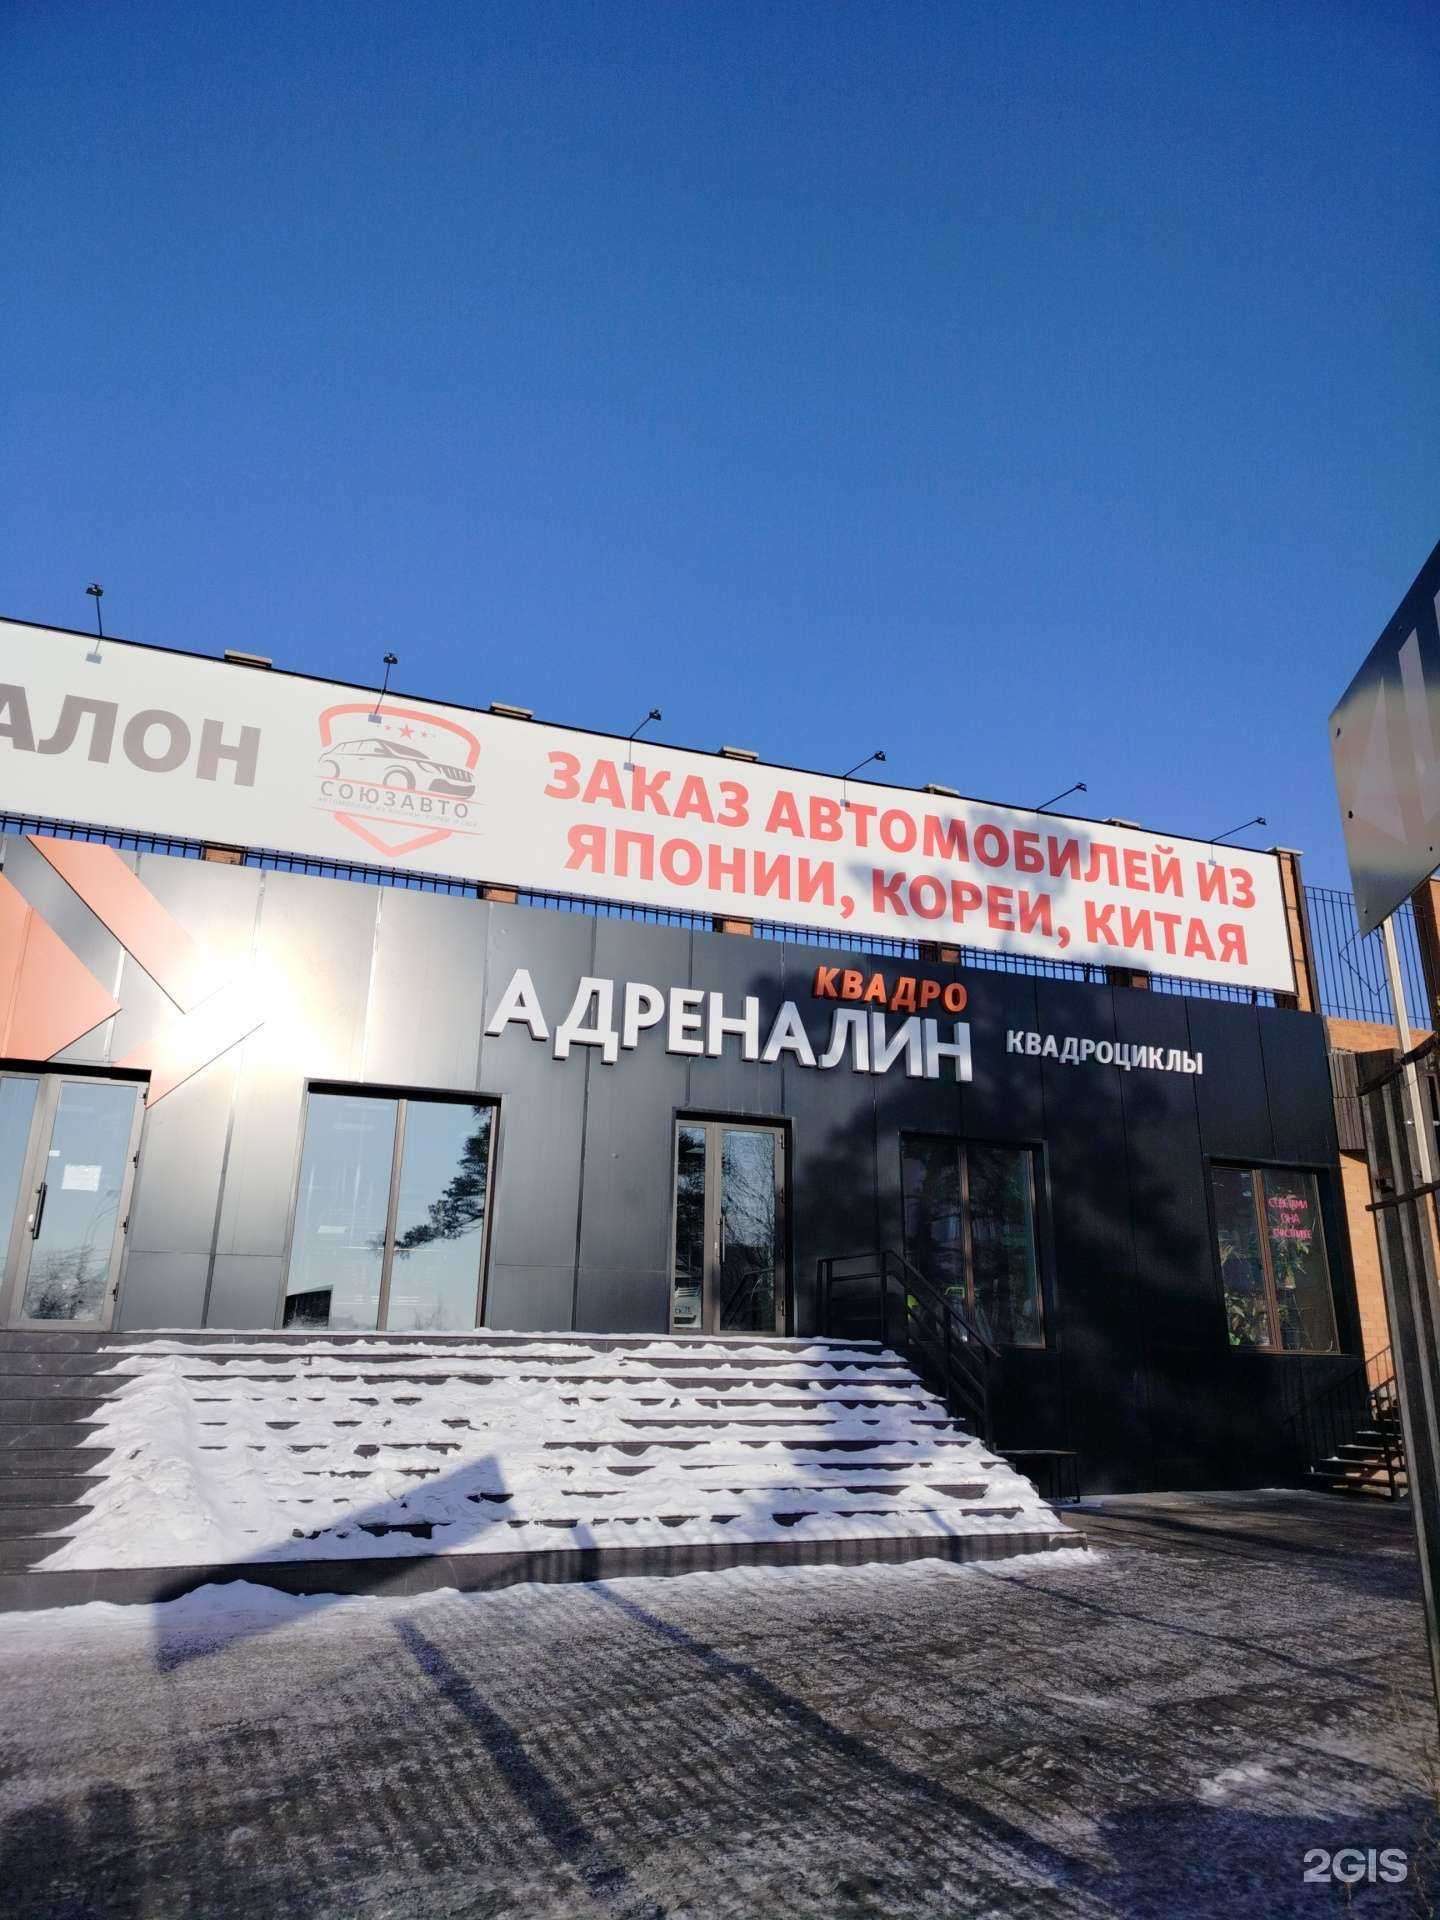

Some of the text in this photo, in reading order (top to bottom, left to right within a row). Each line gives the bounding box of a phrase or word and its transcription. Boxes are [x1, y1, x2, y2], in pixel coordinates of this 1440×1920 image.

[320, 780, 469, 819] СОЮЗАВТО
[545, 751, 750, 827] ЗАКАЗ
[766, 791, 1184, 897] АВТОМОБИЛЕЙ
[1196, 862, 1256, 909] ИЗ
[565, 824, 1249, 966] ЯПОНИИ, КОРЕИ, КИТАЯ
[485, 968, 973, 1082] АДРЕНАЛИН
[815, 966, 968, 1013] КВАДРО
[1006, 1029, 1204, 1075] КВАДРОЦИКЛЫ
